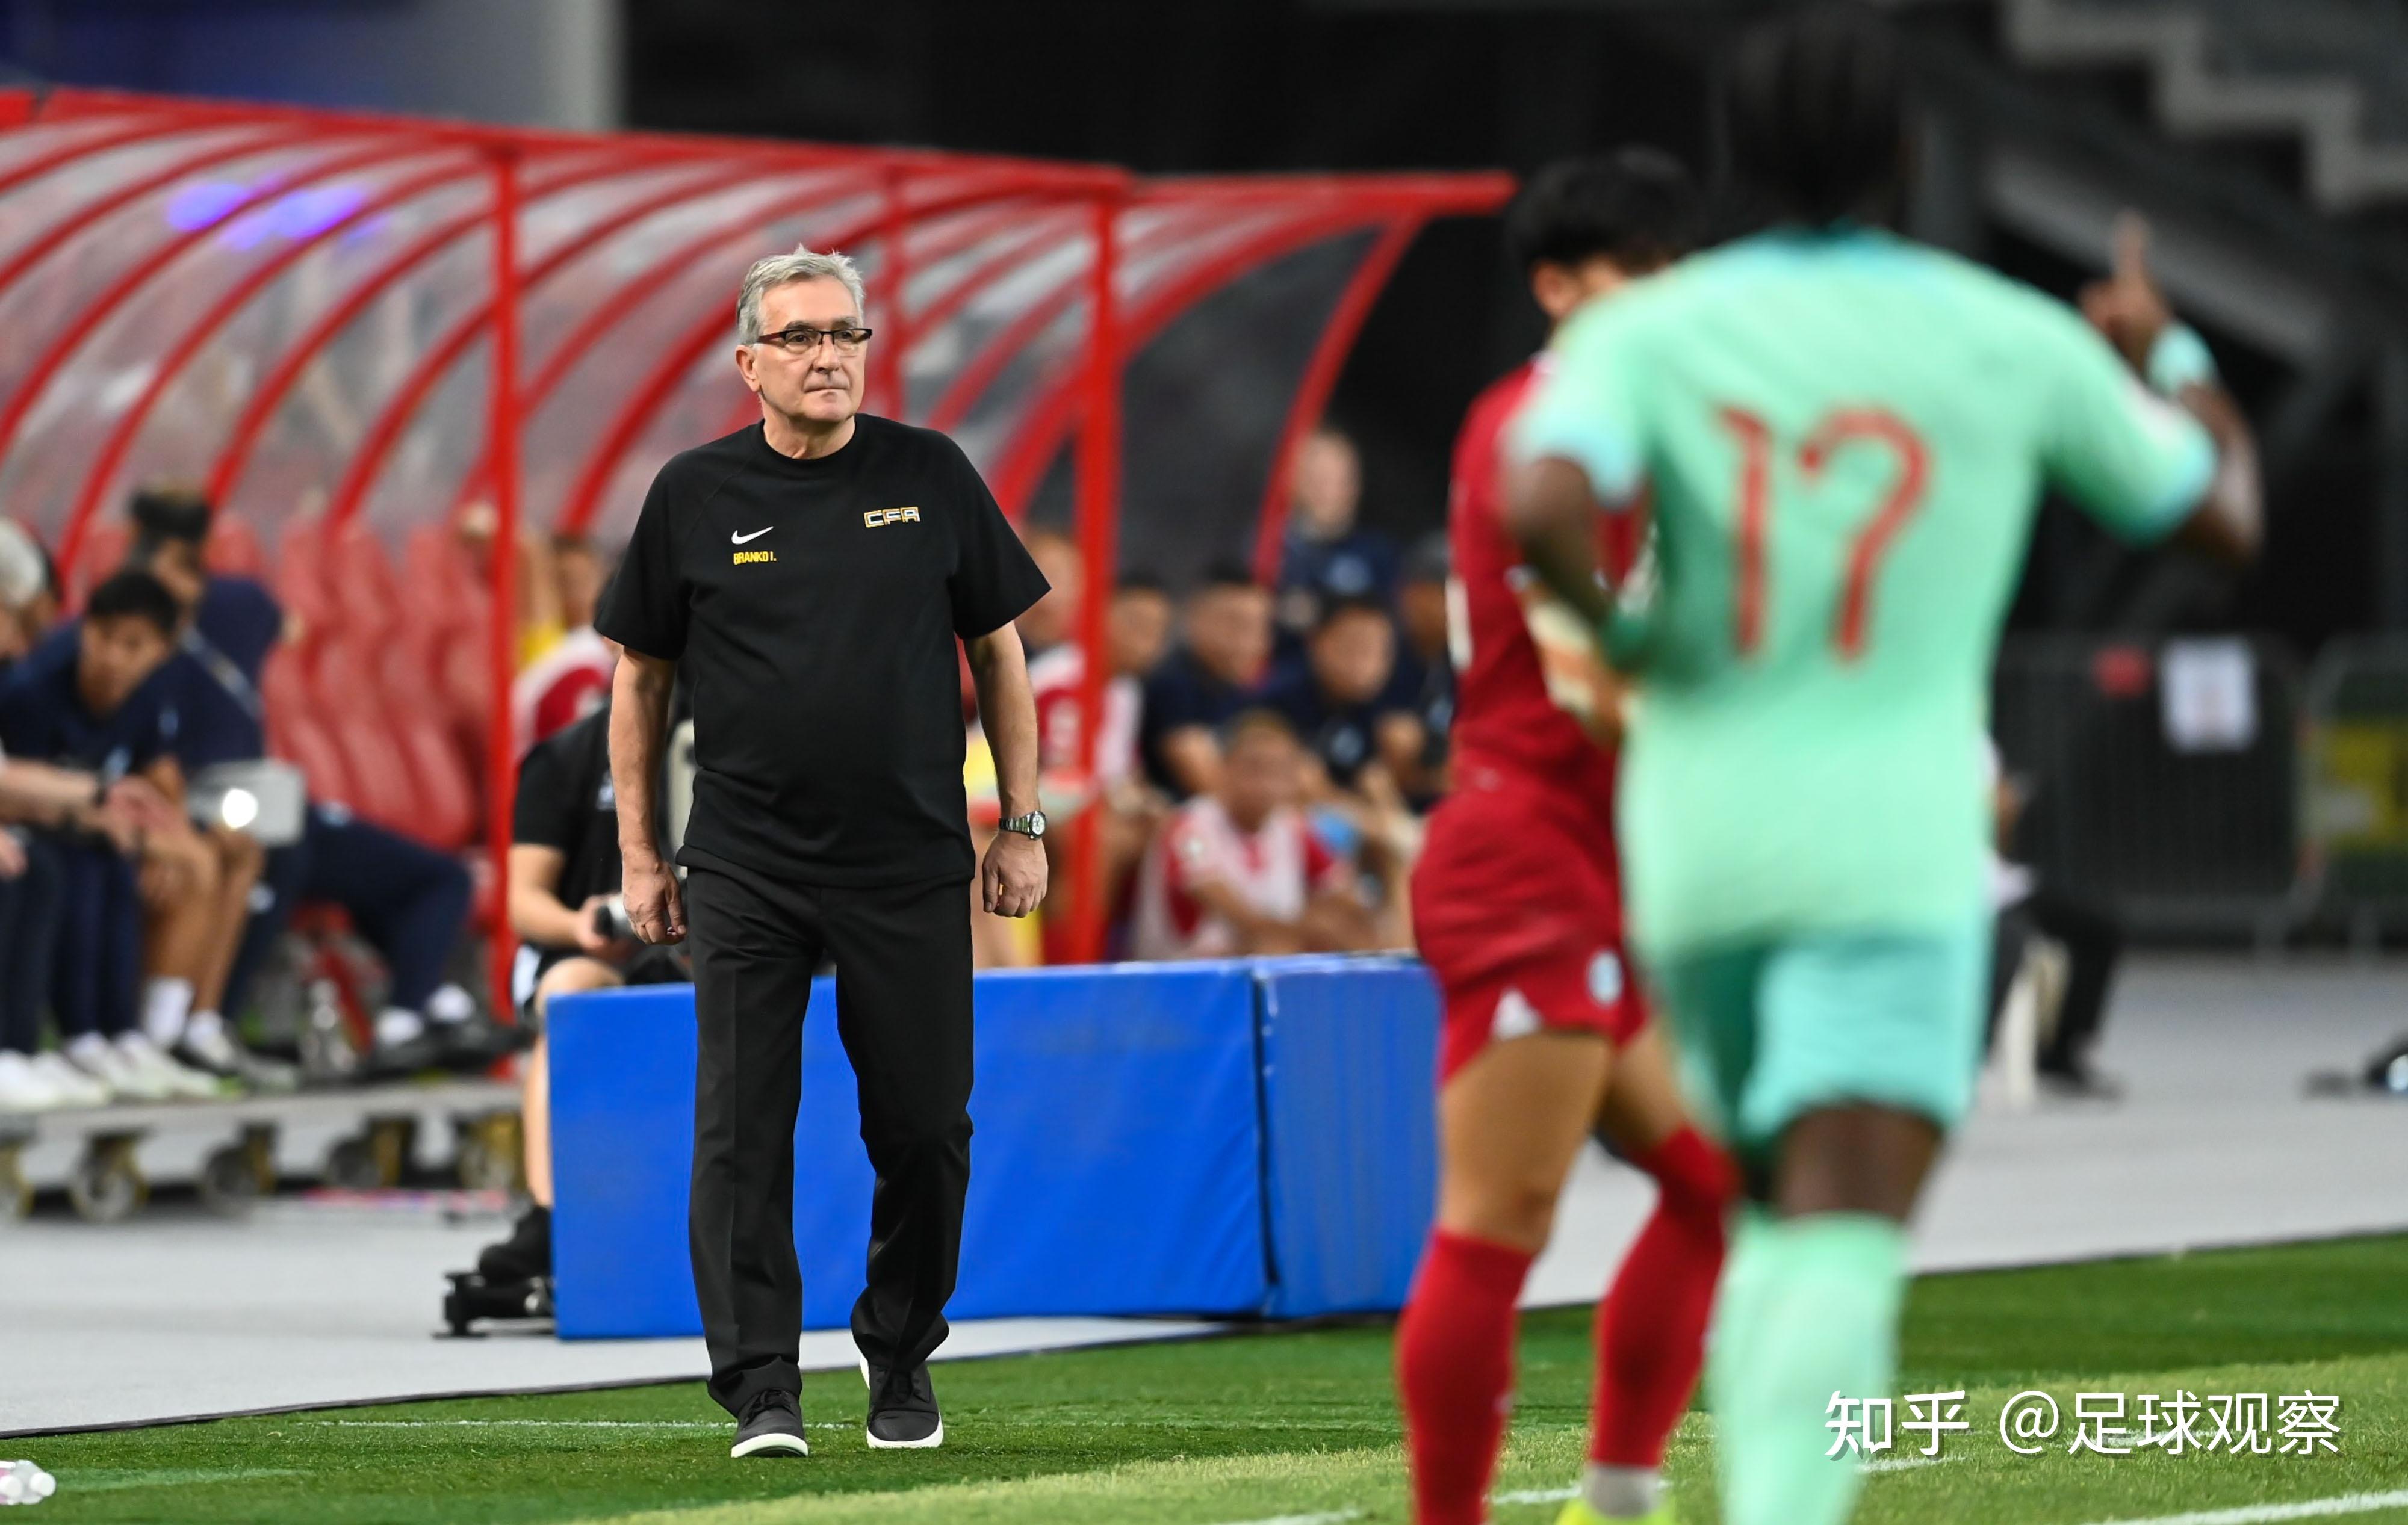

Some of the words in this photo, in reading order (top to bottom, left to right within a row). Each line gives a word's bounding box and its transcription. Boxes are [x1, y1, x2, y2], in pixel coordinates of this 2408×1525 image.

[864, 506, 920, 528] CFA
[1716, 404, 1931, 659] 17
[733, 551, 768, 565] BRANKO
